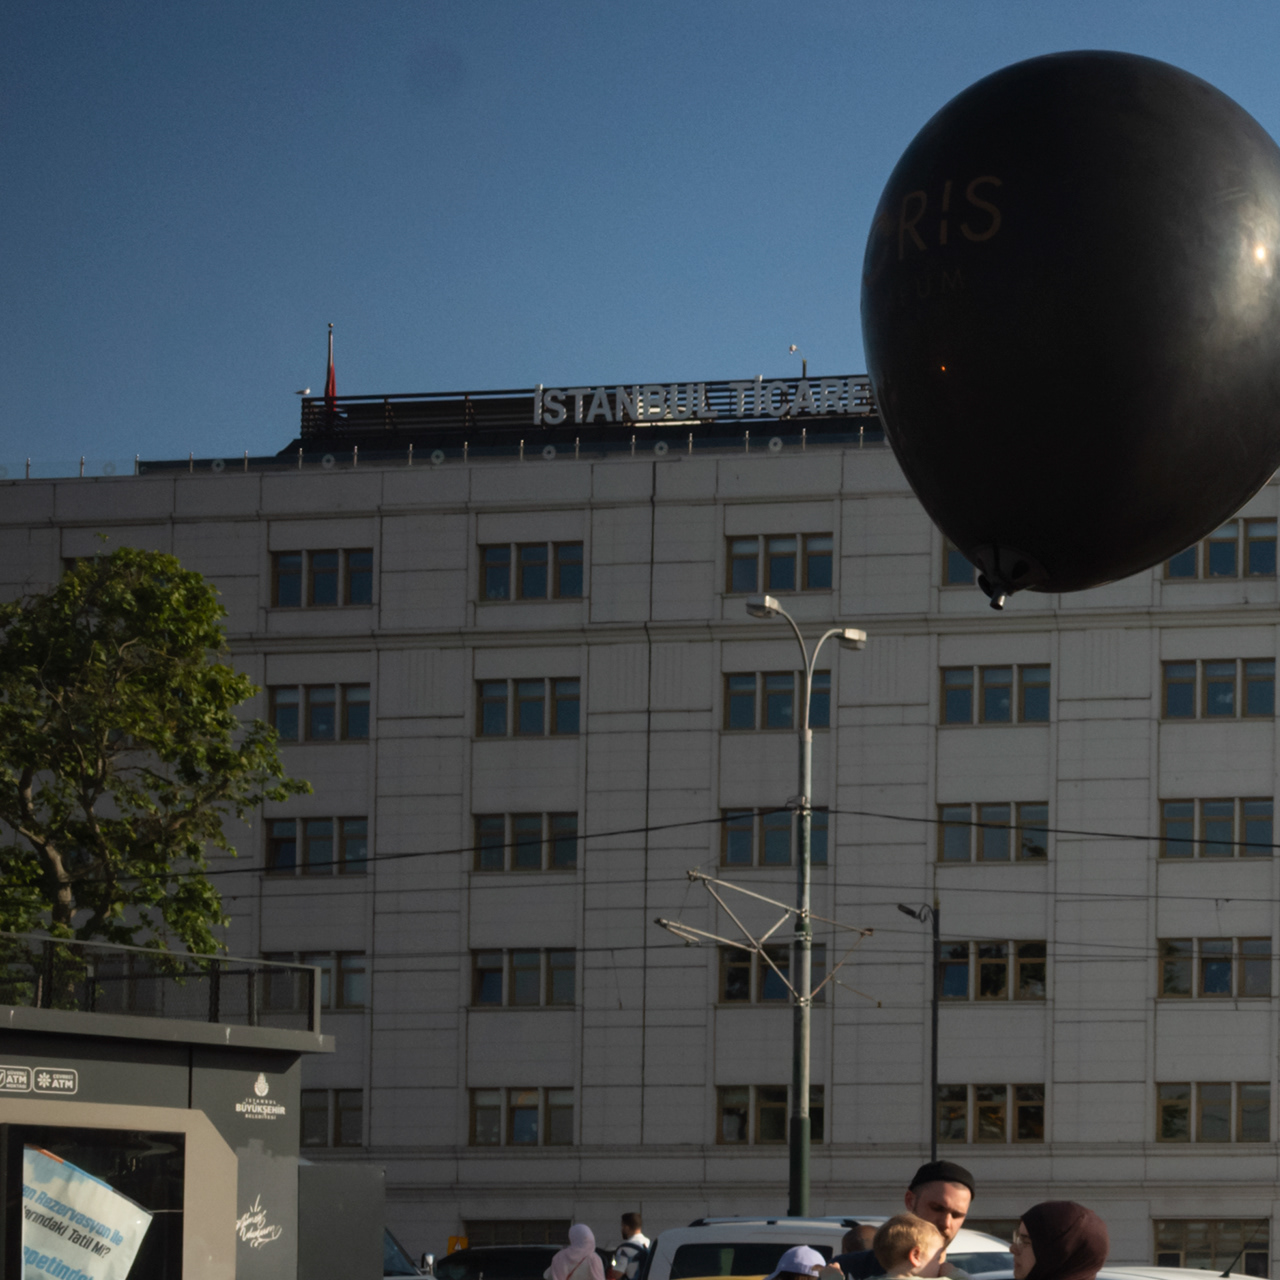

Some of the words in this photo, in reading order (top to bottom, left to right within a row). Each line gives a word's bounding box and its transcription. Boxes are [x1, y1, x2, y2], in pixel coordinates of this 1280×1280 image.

[533, 383, 718, 425] İSTANBUL
[6, 1075, 27, 1084] ATM
[51, 1079, 74, 1089] ATM
[235, 1101, 286, 1115] BÜYÜKŞEHİR
[67, 1228, 95, 1250] Tatil
